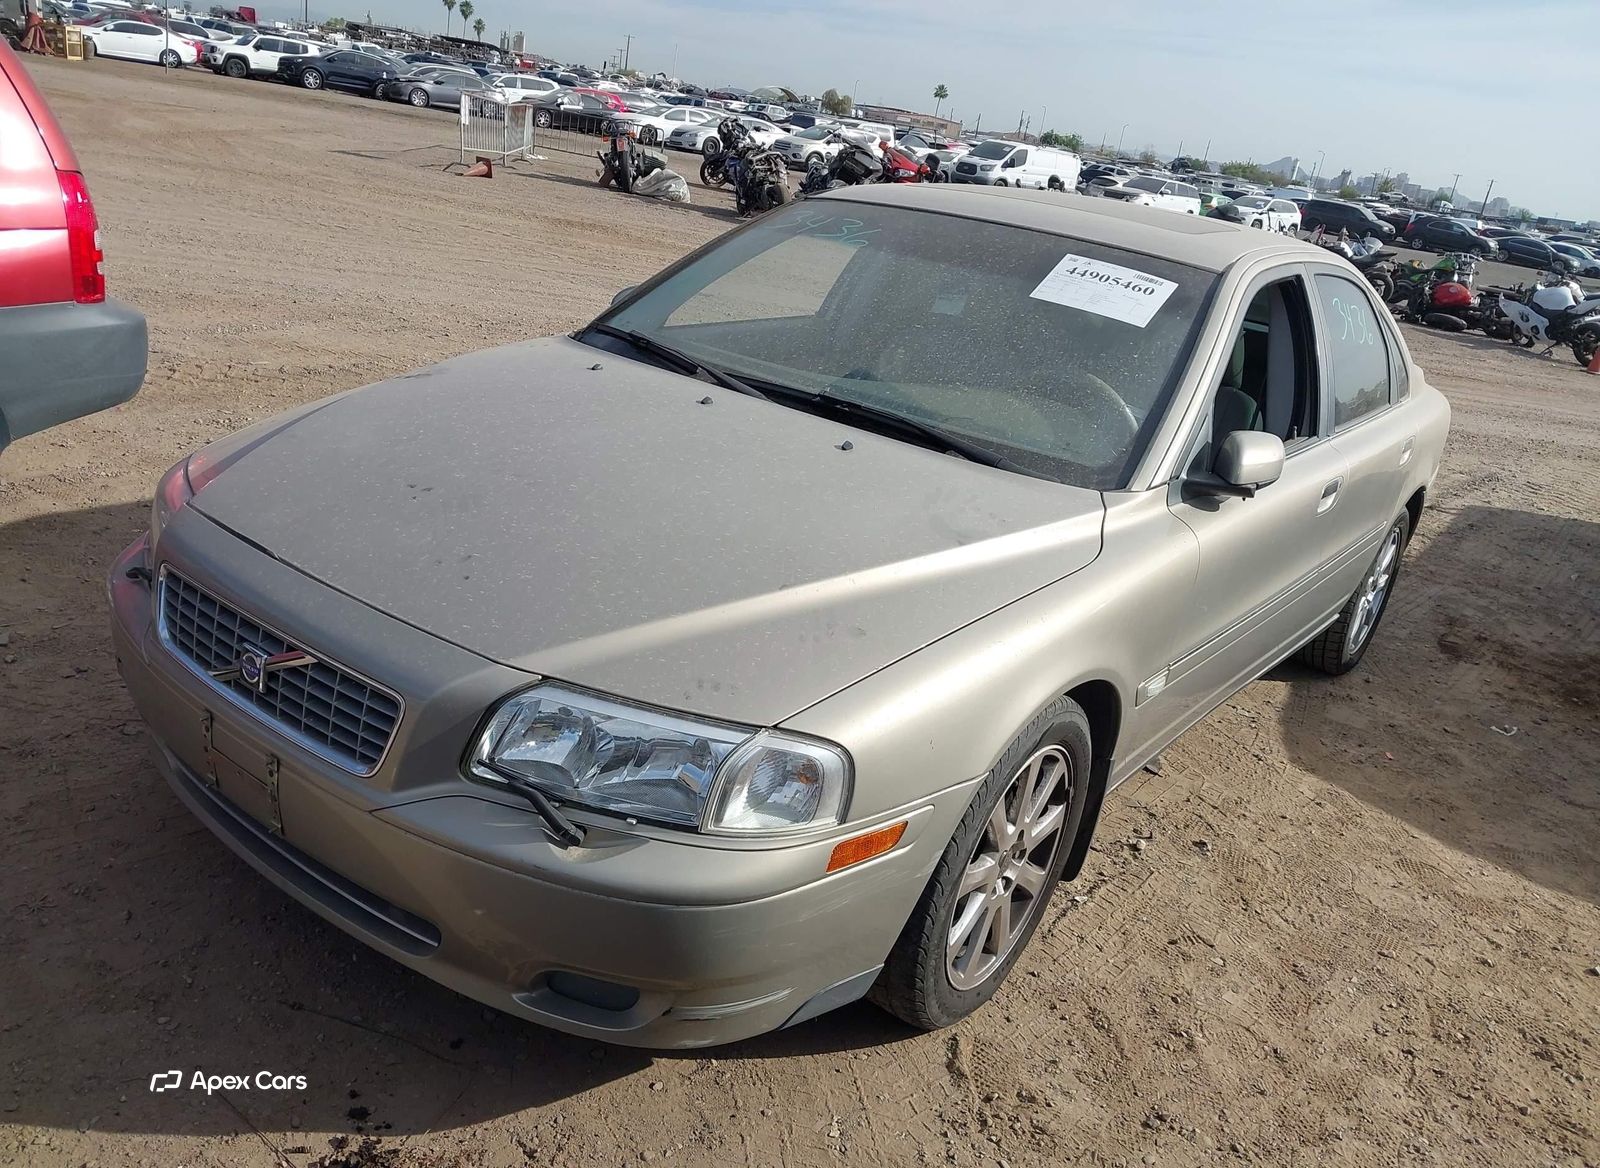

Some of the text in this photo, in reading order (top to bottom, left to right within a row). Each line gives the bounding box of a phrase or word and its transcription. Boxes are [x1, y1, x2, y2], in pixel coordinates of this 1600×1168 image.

[763, 210, 882, 248] 3436
[1065, 266, 1156, 296] 44905460
[1332, 298, 1373, 345] 3436
